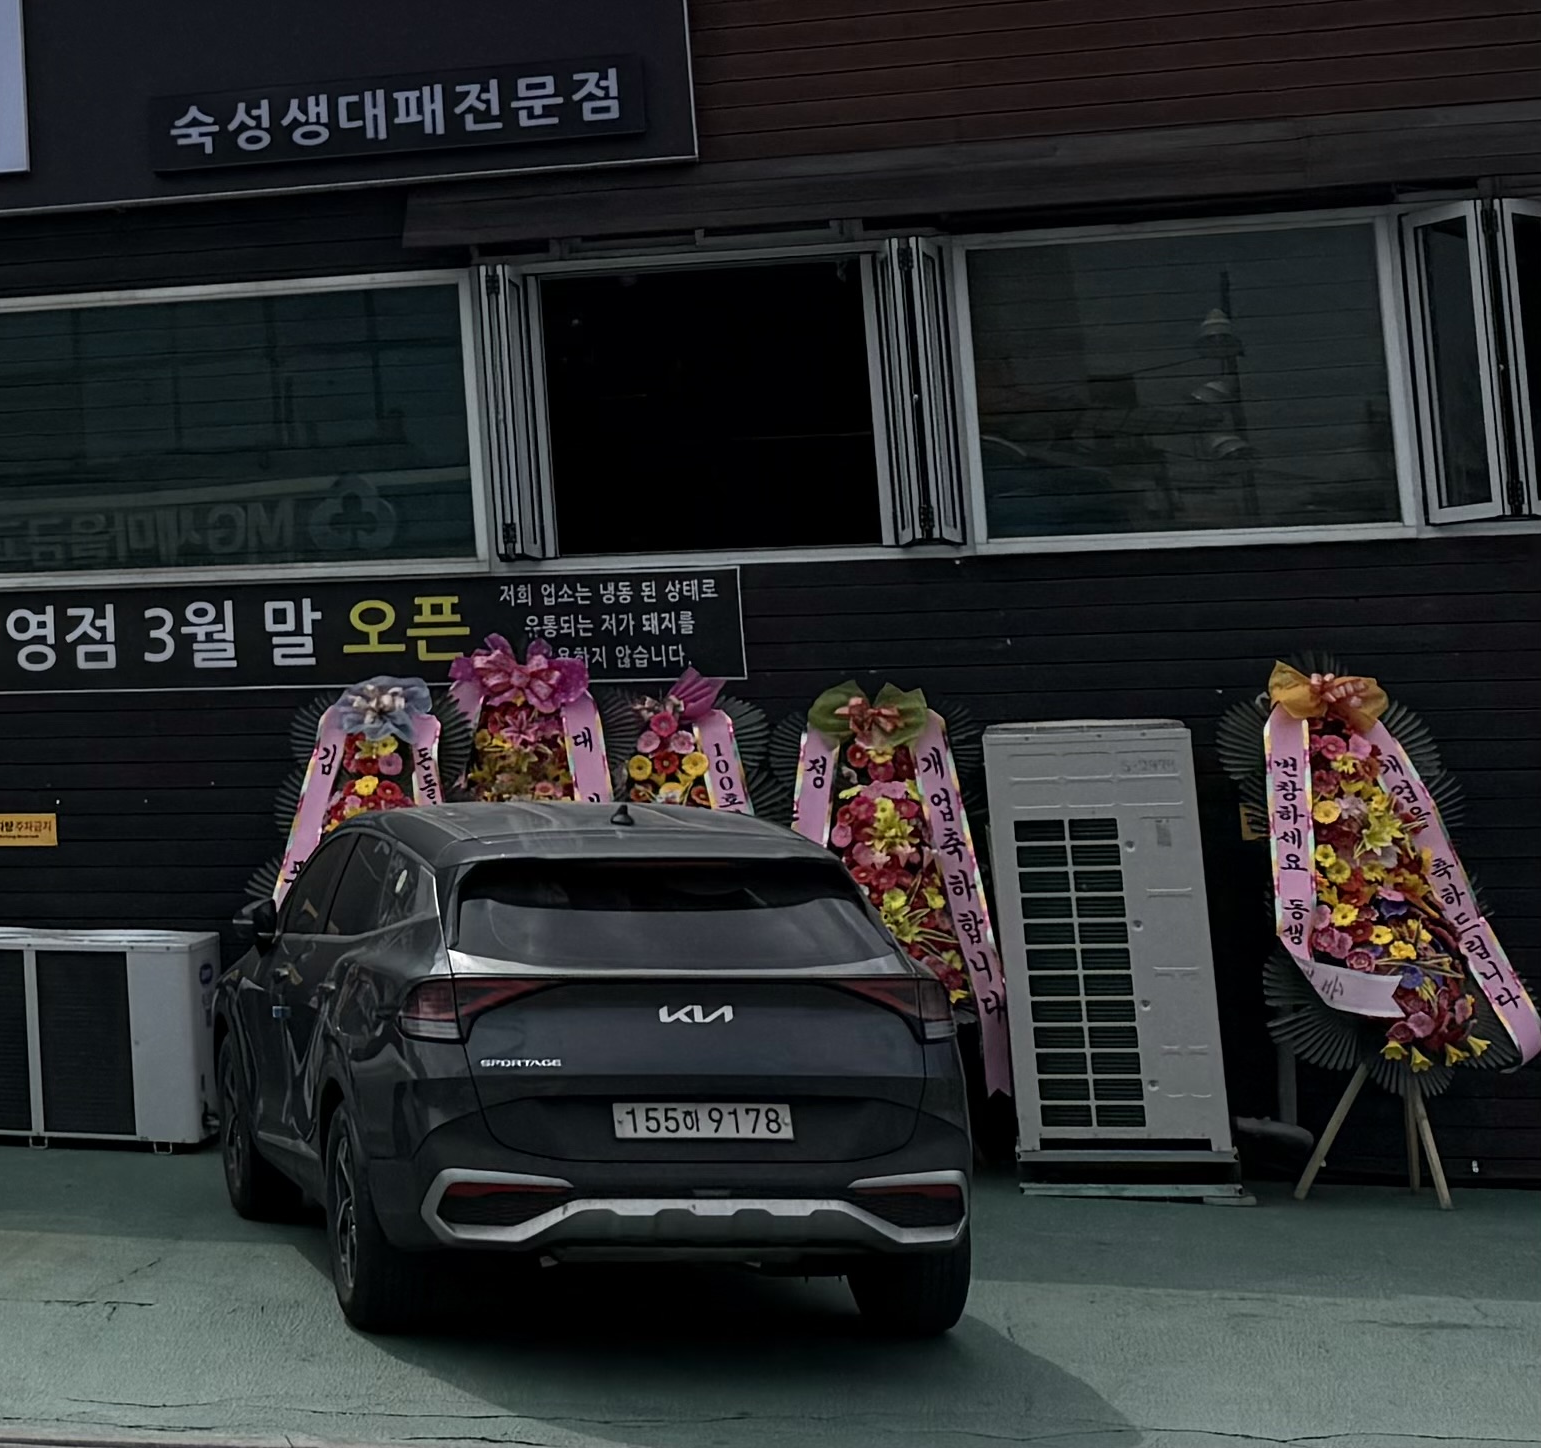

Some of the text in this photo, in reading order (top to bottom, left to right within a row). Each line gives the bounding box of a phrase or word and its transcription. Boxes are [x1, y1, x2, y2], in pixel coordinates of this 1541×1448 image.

[169, 67, 621, 155] 숙성생대패전문점
[499, 578, 719, 607] 저희 업소는 냉동 된 상태로
[142, 598, 238, 670] 3월
[263, 596, 323, 667] 말
[342, 594, 472, 662] 오픈
[524, 610, 696, 639] 유통되는 저가 돼지를
[614, 643, 693, 669] 않습니다.
[416, 747, 437, 804] 돈돌
[658, 1004, 734, 1024] KIA
[480, 1057, 562, 1068] SPORTAGE
[625, 1107, 782, 1133] 155하 9178
